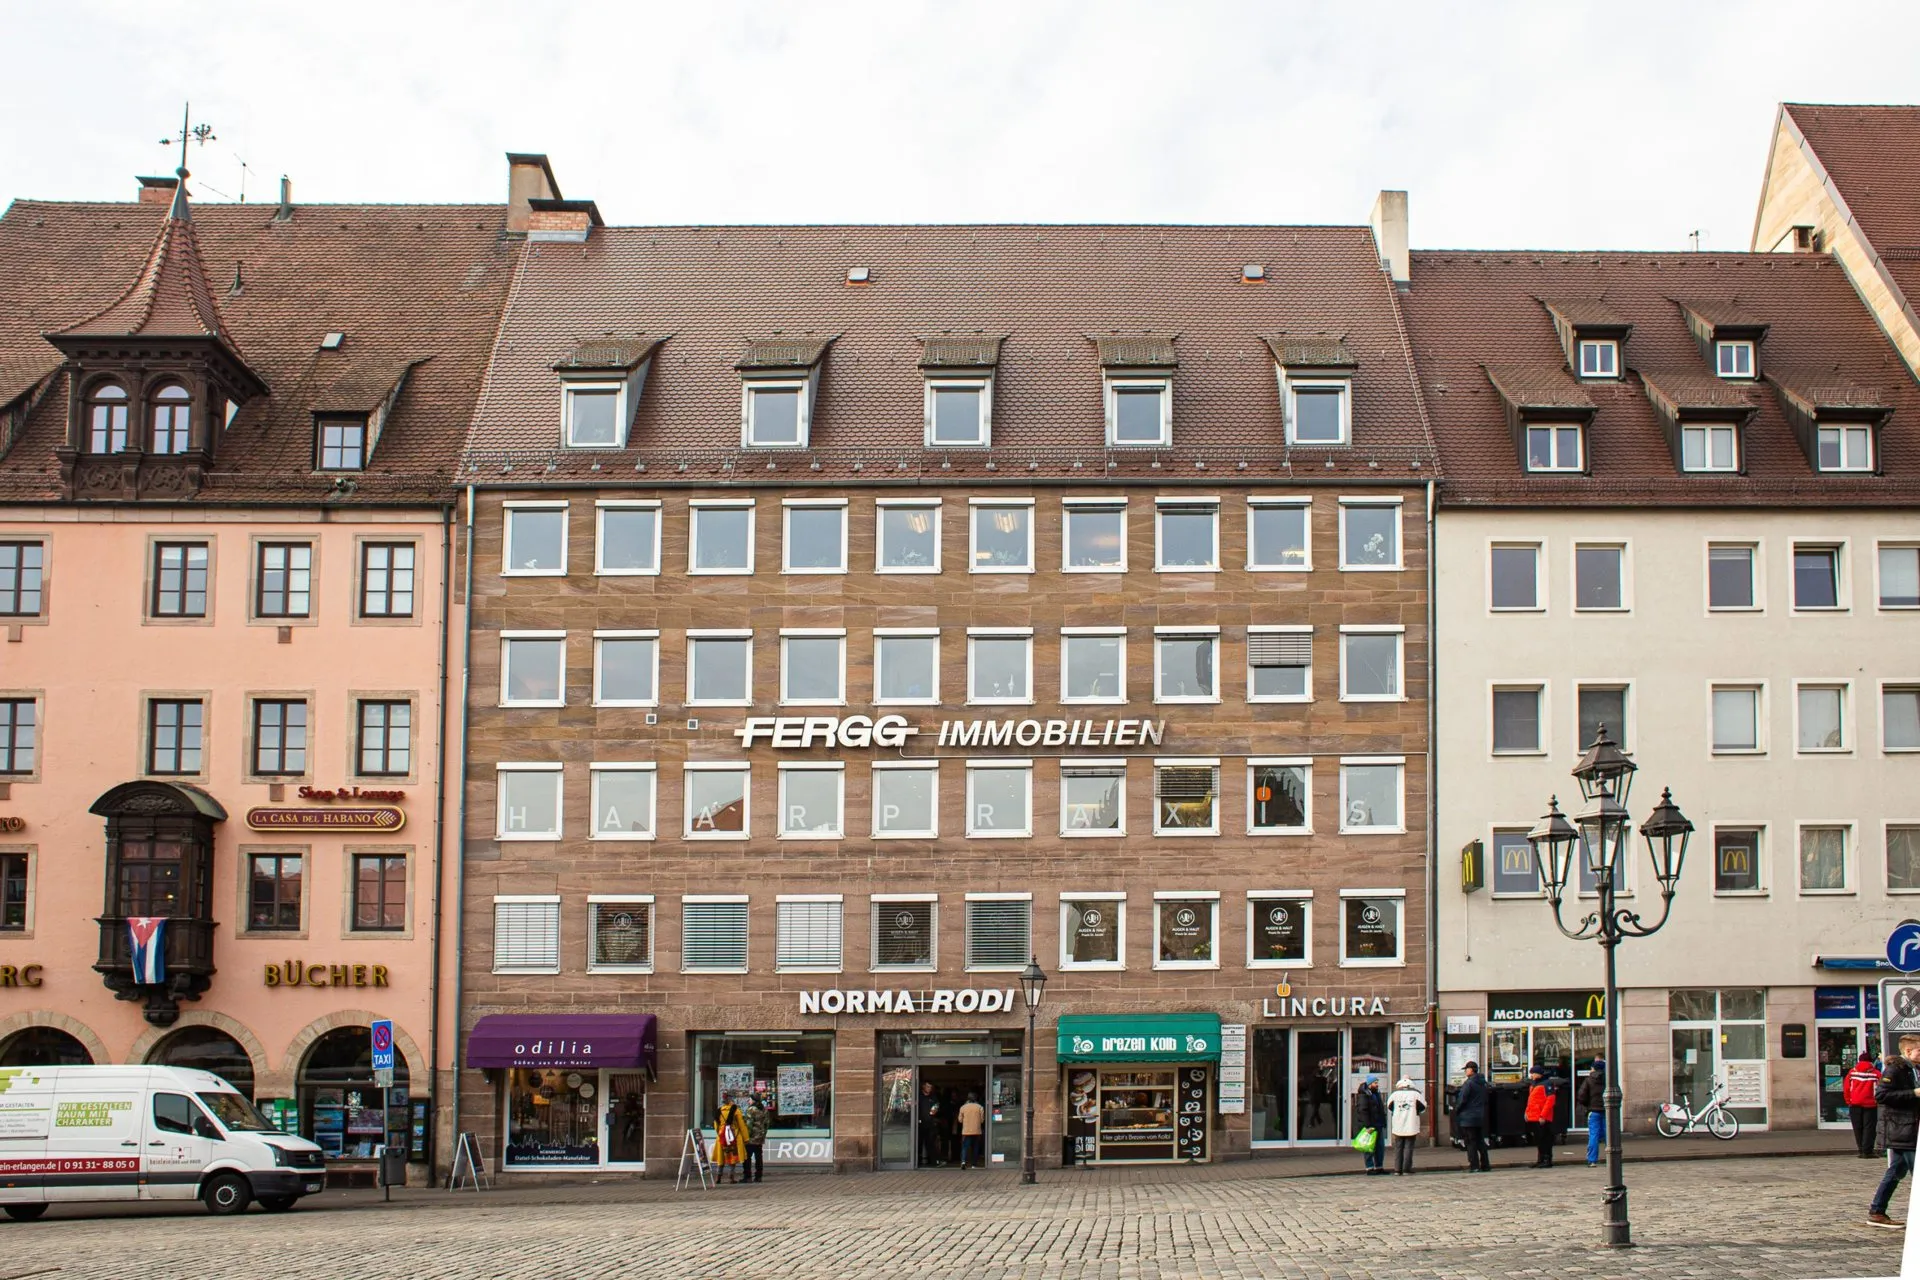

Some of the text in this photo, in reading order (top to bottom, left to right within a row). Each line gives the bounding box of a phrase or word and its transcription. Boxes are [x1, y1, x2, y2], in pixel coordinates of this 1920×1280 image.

[734, 714, 1166, 748] FERGG IMMOBILIEN
[298, 786, 406, 801] Shop & Lounge
[255, 813, 371, 823] LA CASA DEL HABANO
[264, 960, 389, 987] BÜCHER
[800, 988, 1015, 1014] NORMA RODI
[1263, 997, 1386, 1017] LINCURA
[1493, 1008, 1575, 1020] McDonald's
[515, 1041, 592, 1054] odilia
[374, 1054, 391, 1065] TAXI
[777, 1142, 832, 1158] RODI
[0, 1162, 56, 1171] ein-erlangen.de
[64, 1161, 70, 1169] 0
[72, 1161, 83, 1169] 91
[102, 1160, 114, 1168] 88
[116, 1160, 127, 1168] 05
[128, 1160, 135, 1168] 0
